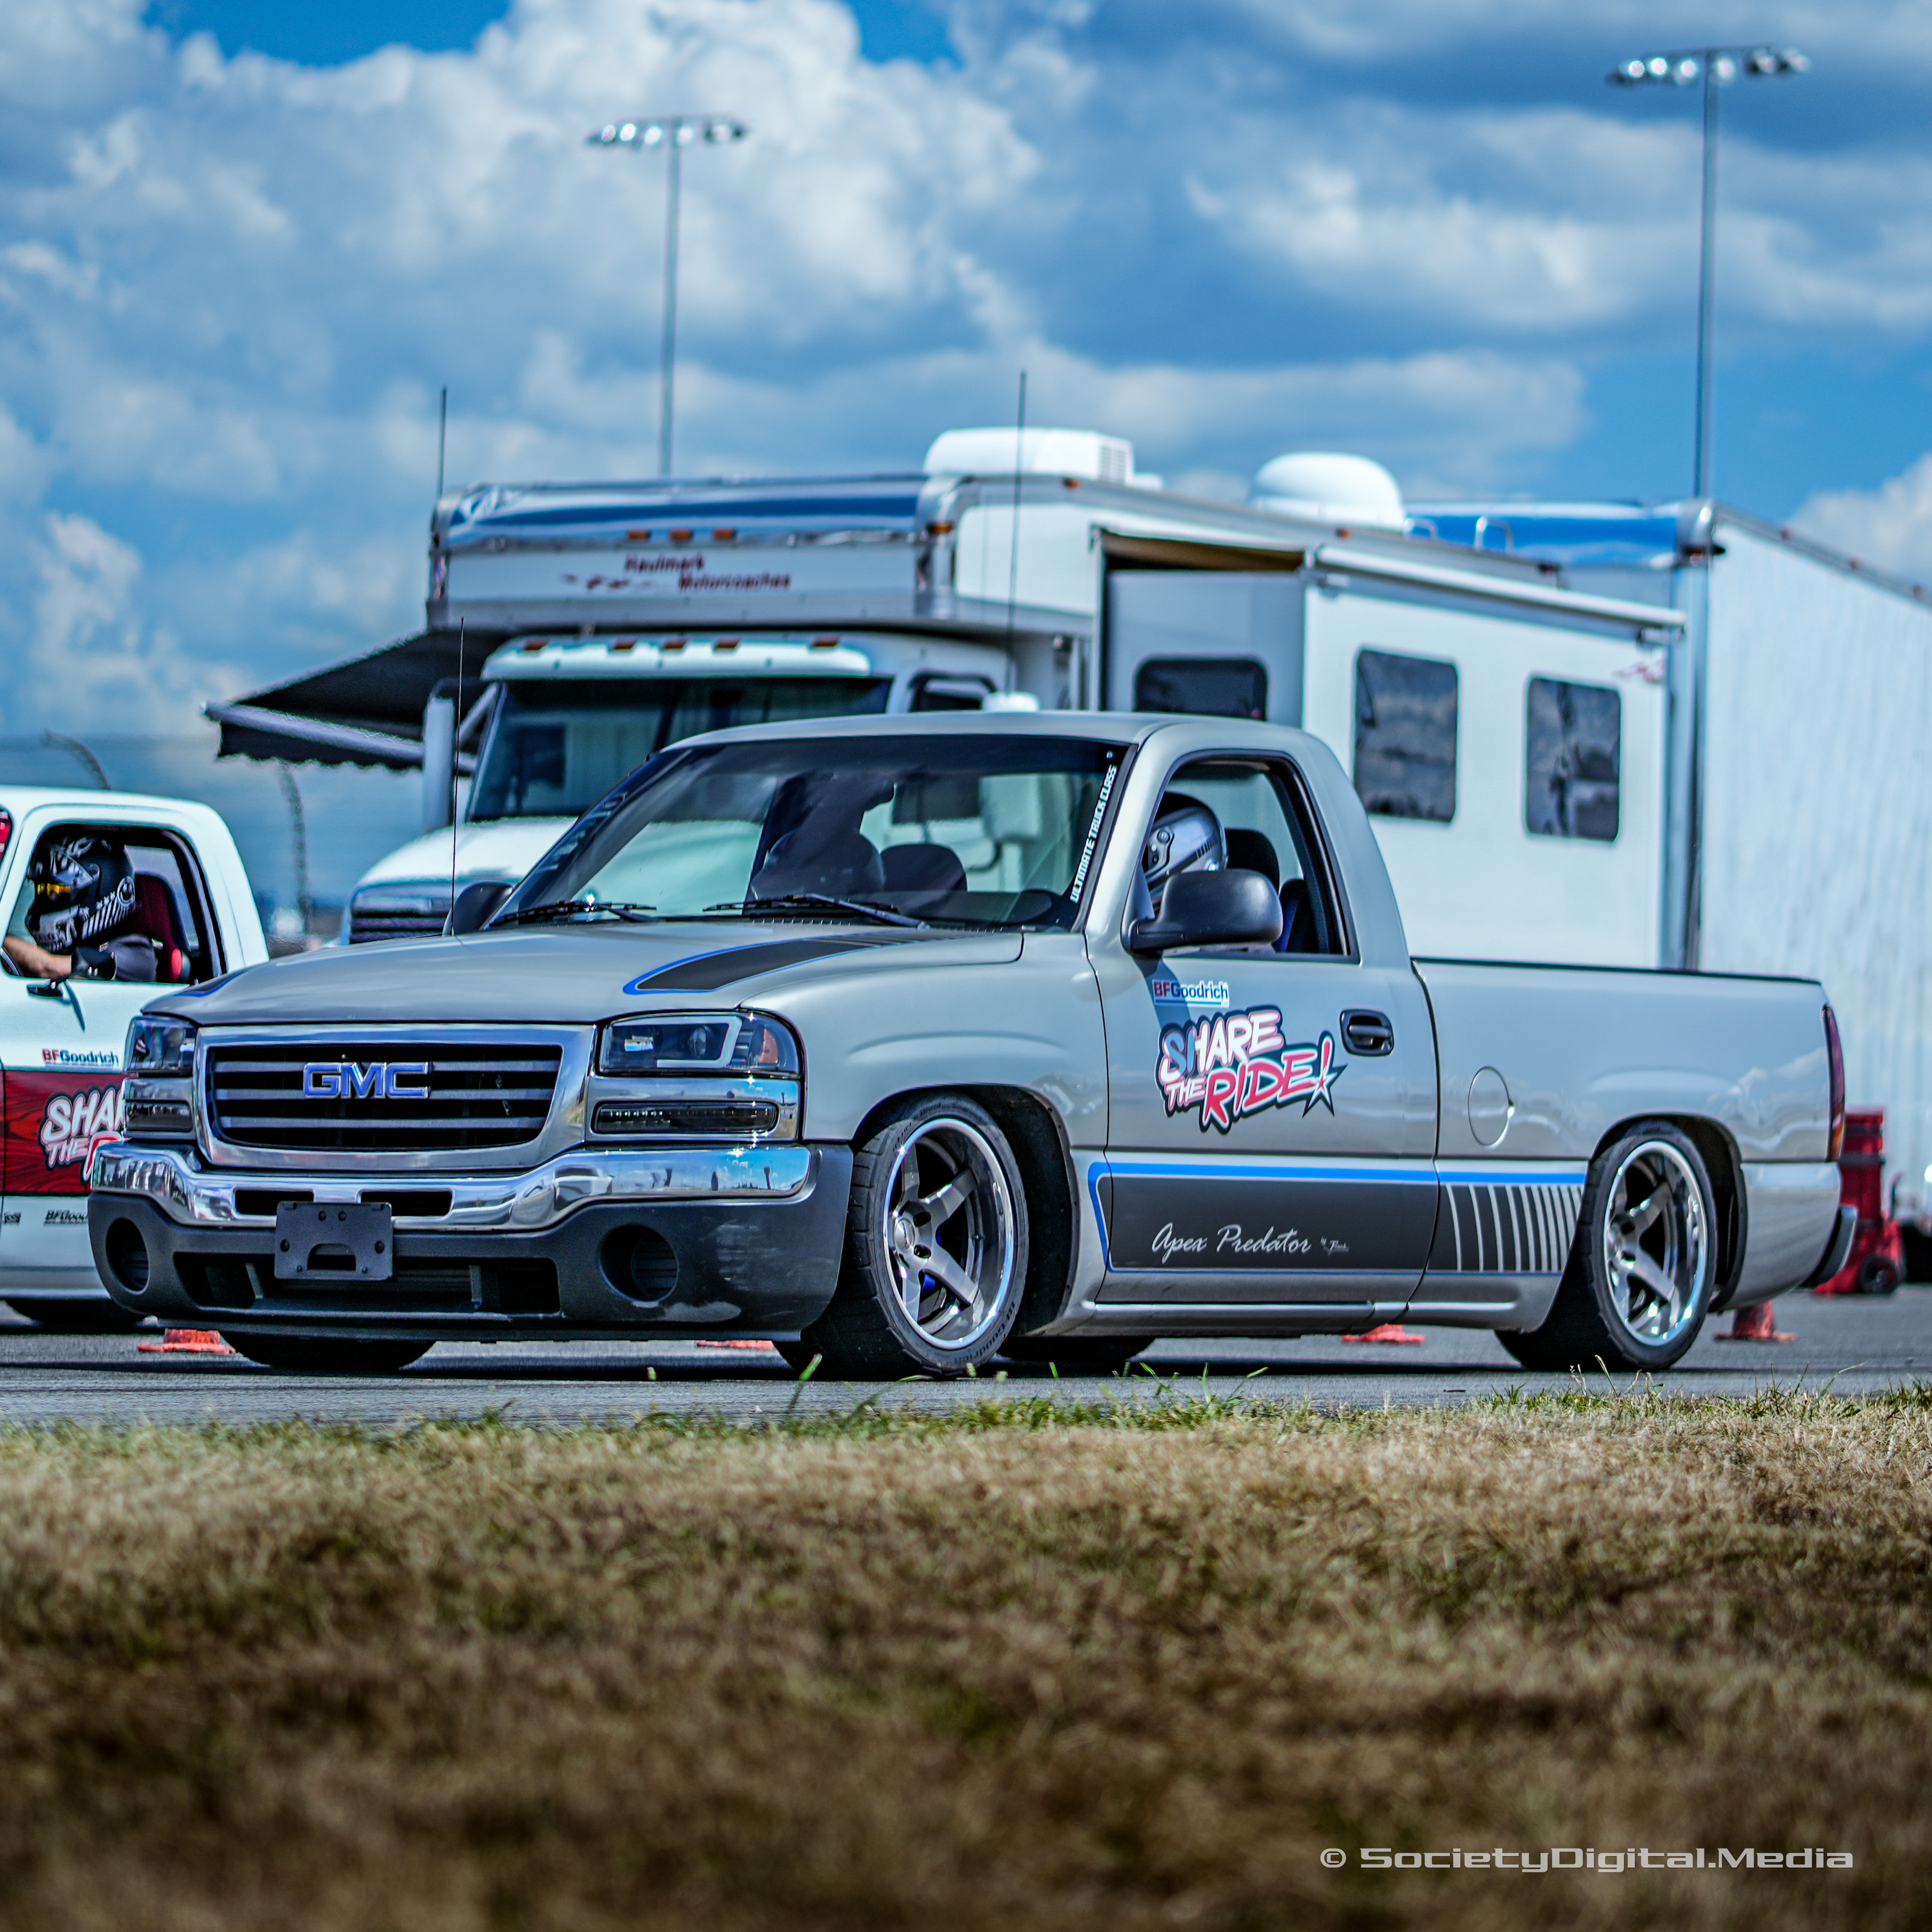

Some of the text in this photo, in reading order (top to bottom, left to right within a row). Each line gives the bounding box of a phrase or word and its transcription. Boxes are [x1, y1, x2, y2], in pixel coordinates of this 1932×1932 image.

[1070, 764, 1118, 903] ULTIMATE TRUCK CLASS
[1153, 981, 1228, 999] BFGoodrich
[42, 1048, 119, 1064] BFGoodrich
[1159, 1009, 1284, 1085] SHARE
[303, 1062, 429, 1099] GMC
[1164, 1035, 1341, 1128] THE RIDE!
[46, 1137, 91, 1168] THE
[1152, 1222, 1208, 1264] Apex
[1216, 1223, 1312, 1253] Predator
